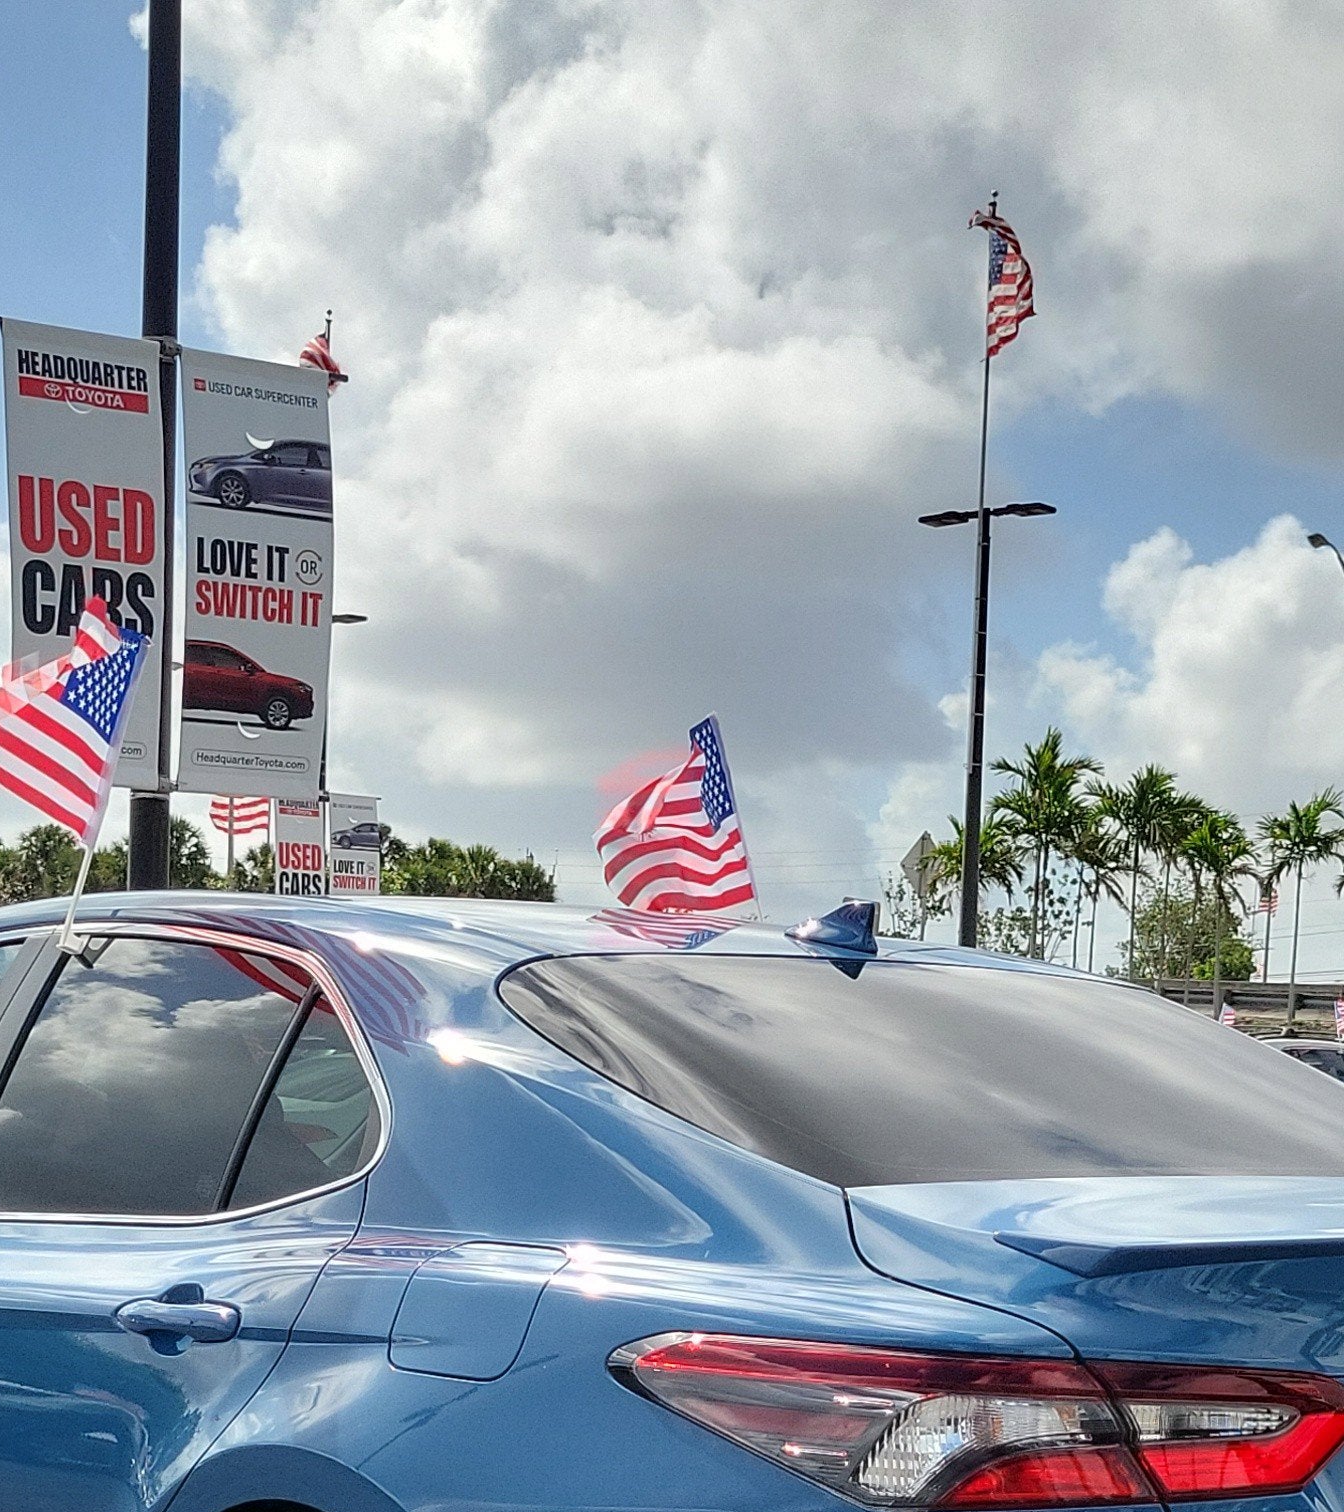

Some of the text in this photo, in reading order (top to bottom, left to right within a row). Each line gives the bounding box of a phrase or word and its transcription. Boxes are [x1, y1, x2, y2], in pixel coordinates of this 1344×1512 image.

[17, 348, 149, 393] HEADQUARTER
[65, 385, 125, 409] TOYOTA
[207, 380, 319, 409] USED CAR SUPERCENTER
[17, 474, 156, 566] USED
[196, 536, 318, 583] LOVE IT OR
[21, 558, 156, 640] CARS
[195, 579, 323, 628] SWITCH IT
[196, 751, 306, 771] HeadquarterToyota.com
[278, 841, 322, 872] USED
[333, 859, 355, 875] LOVE
[356, 860, 366, 875] IT
[279, 871, 322, 896] CARS
[332, 874, 377, 891] SWITCH IT
